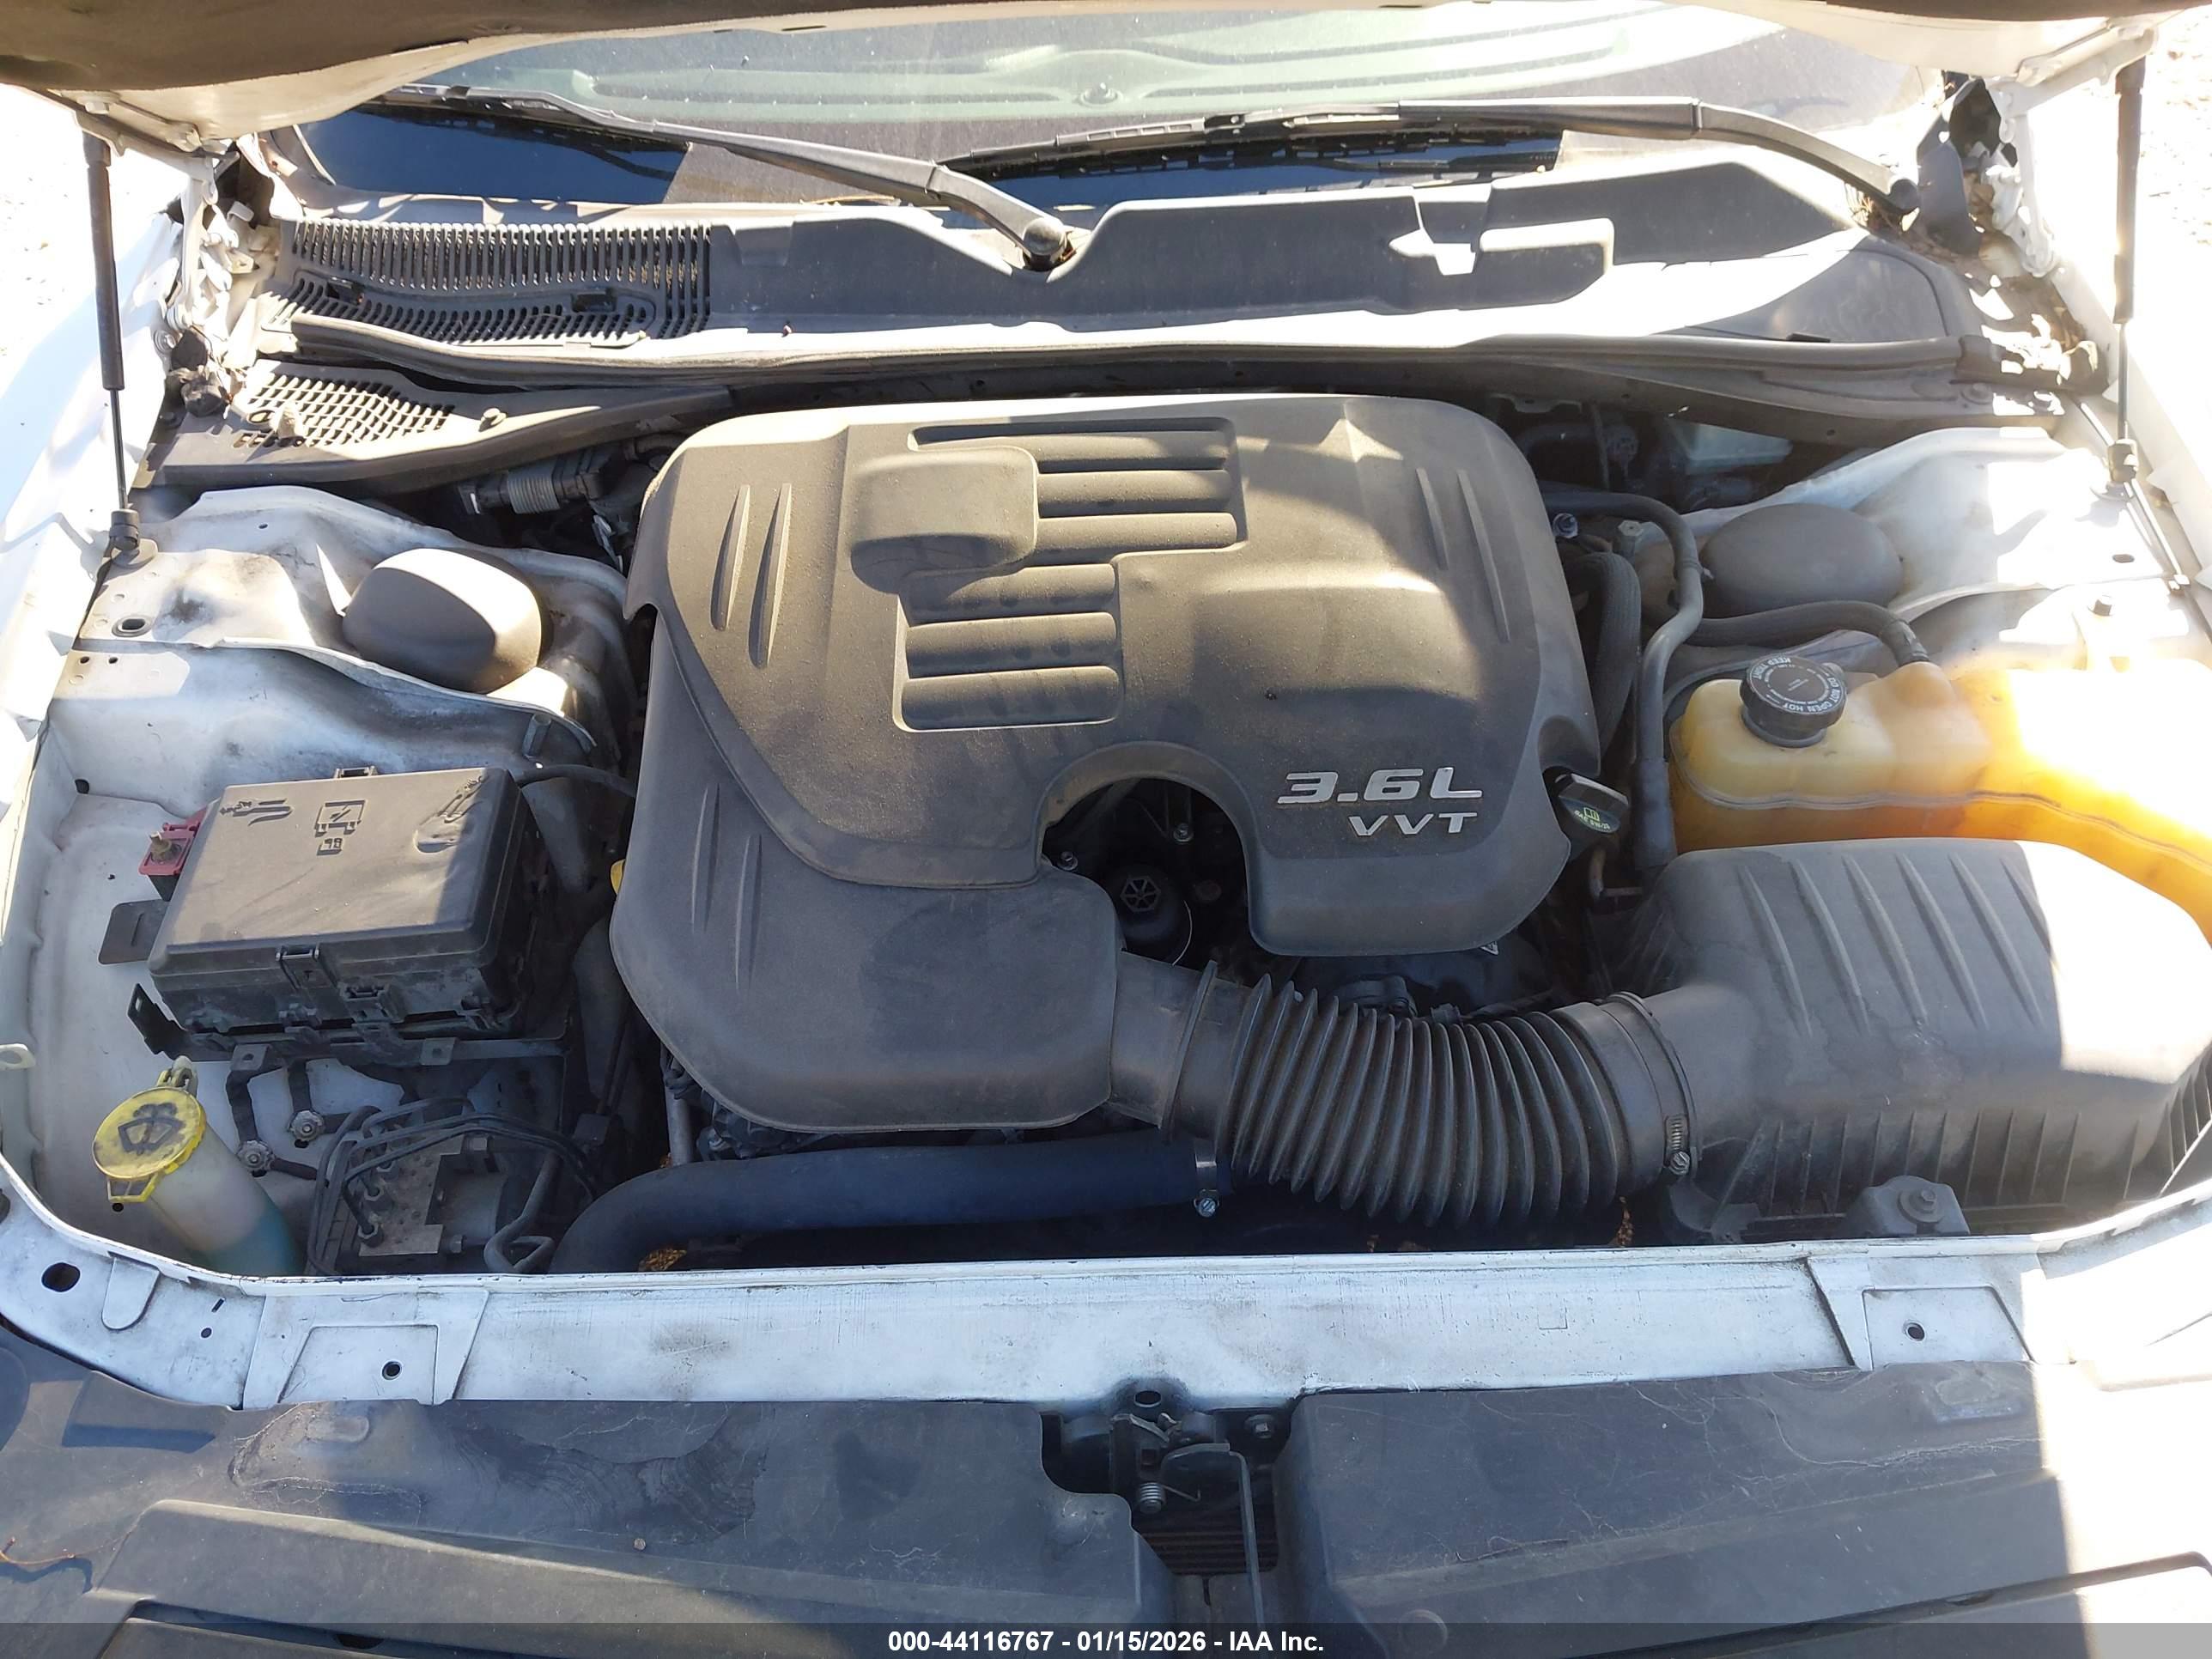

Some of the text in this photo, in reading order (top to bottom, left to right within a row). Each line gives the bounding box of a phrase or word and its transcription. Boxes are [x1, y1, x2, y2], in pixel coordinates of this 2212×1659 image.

[1827, 677, 1839, 687] DO
[1829, 689, 1841, 702] NOT
[1782, 702, 1803, 711] HOT
[1807, 701, 1832, 712] OPEN
[1278, 767, 1482, 804] 3.6L
[1348, 812, 1477, 836] VVT
